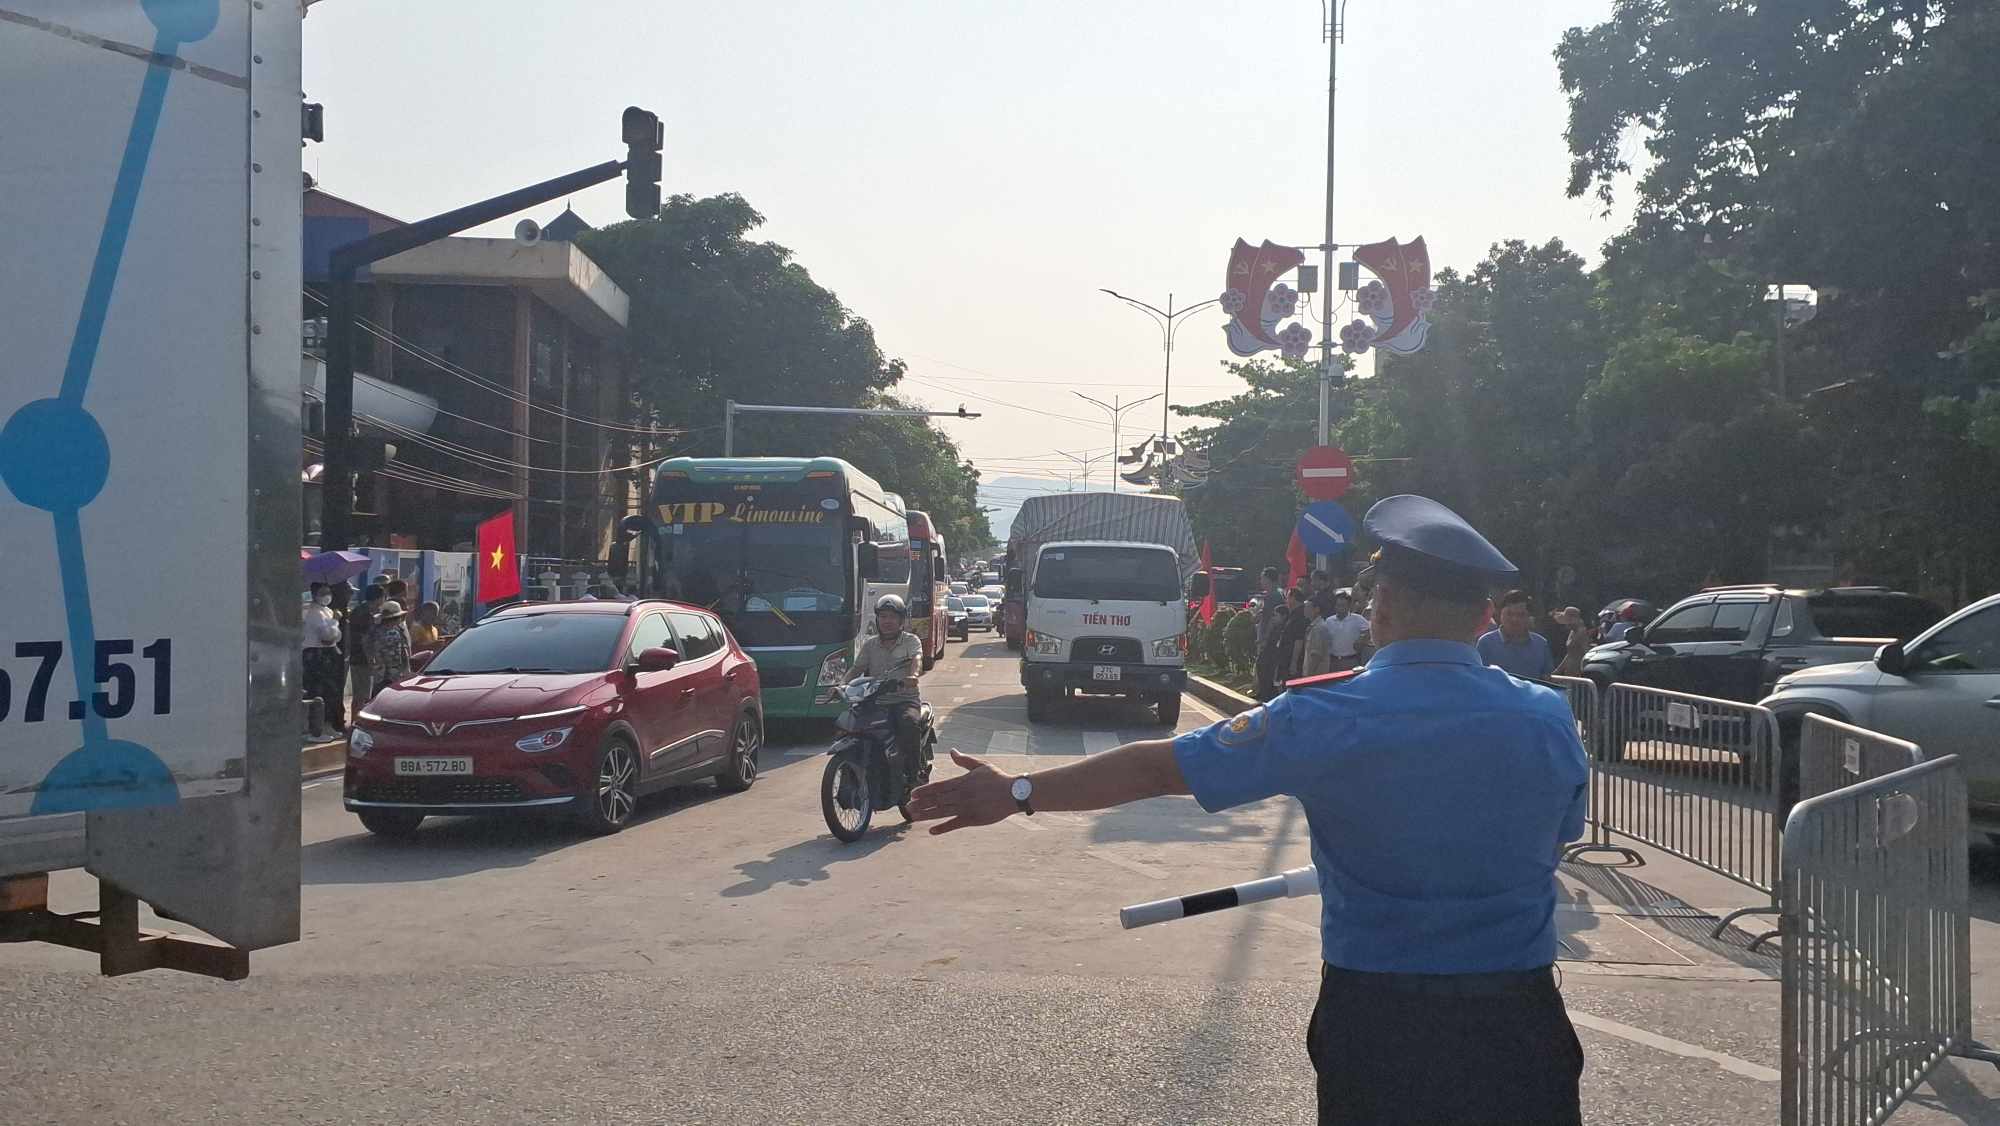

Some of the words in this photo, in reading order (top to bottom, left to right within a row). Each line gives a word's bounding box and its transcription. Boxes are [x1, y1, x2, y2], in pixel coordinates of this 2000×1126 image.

[658, 502, 727, 525] VIP
[729, 502, 825, 524] Limousine
[0, 638, 172, 723] 7.51
